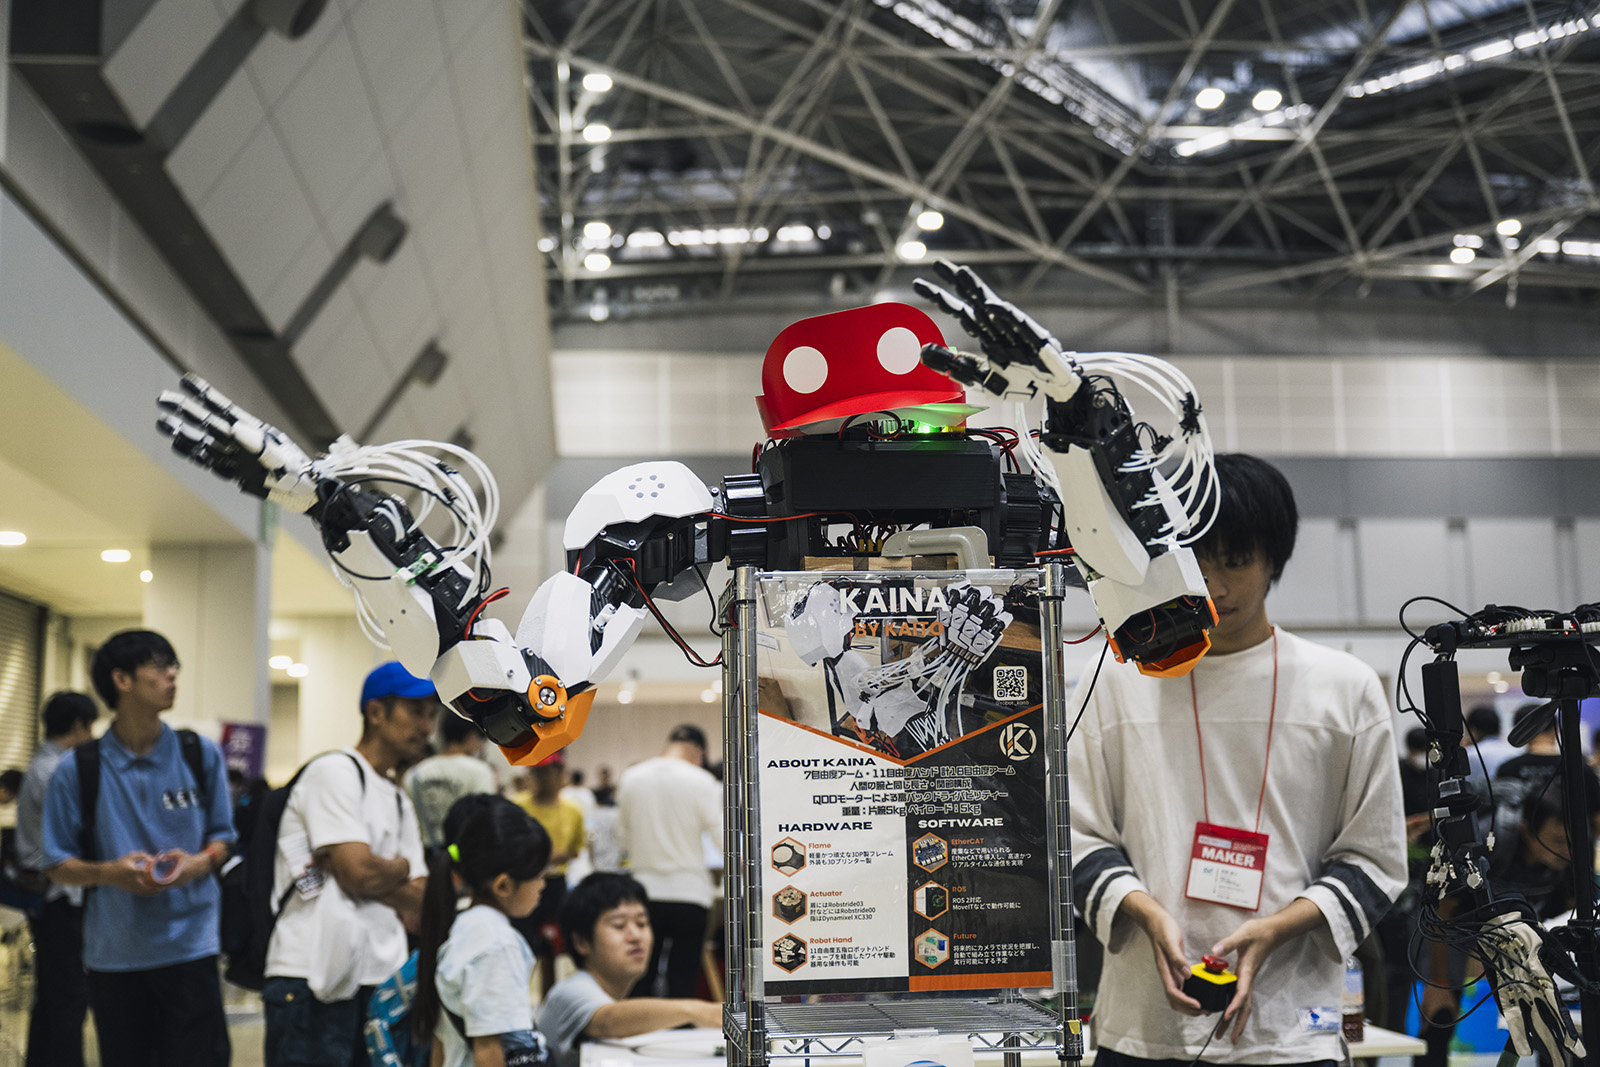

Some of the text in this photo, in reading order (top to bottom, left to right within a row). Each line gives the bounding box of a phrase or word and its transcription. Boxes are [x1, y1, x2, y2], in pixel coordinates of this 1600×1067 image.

[839, 587, 951, 613] KAINA
[854, 621, 944, 638] BY KAITO
[767, 758, 876, 769] ABOUT KAINA
[778, 821, 873, 832] HARDWARE
[918, 817, 1004, 829] SOFTWARE
[1201, 846, 1255, 867] MAKER
[809, 936, 853, 945] Robot Hand
